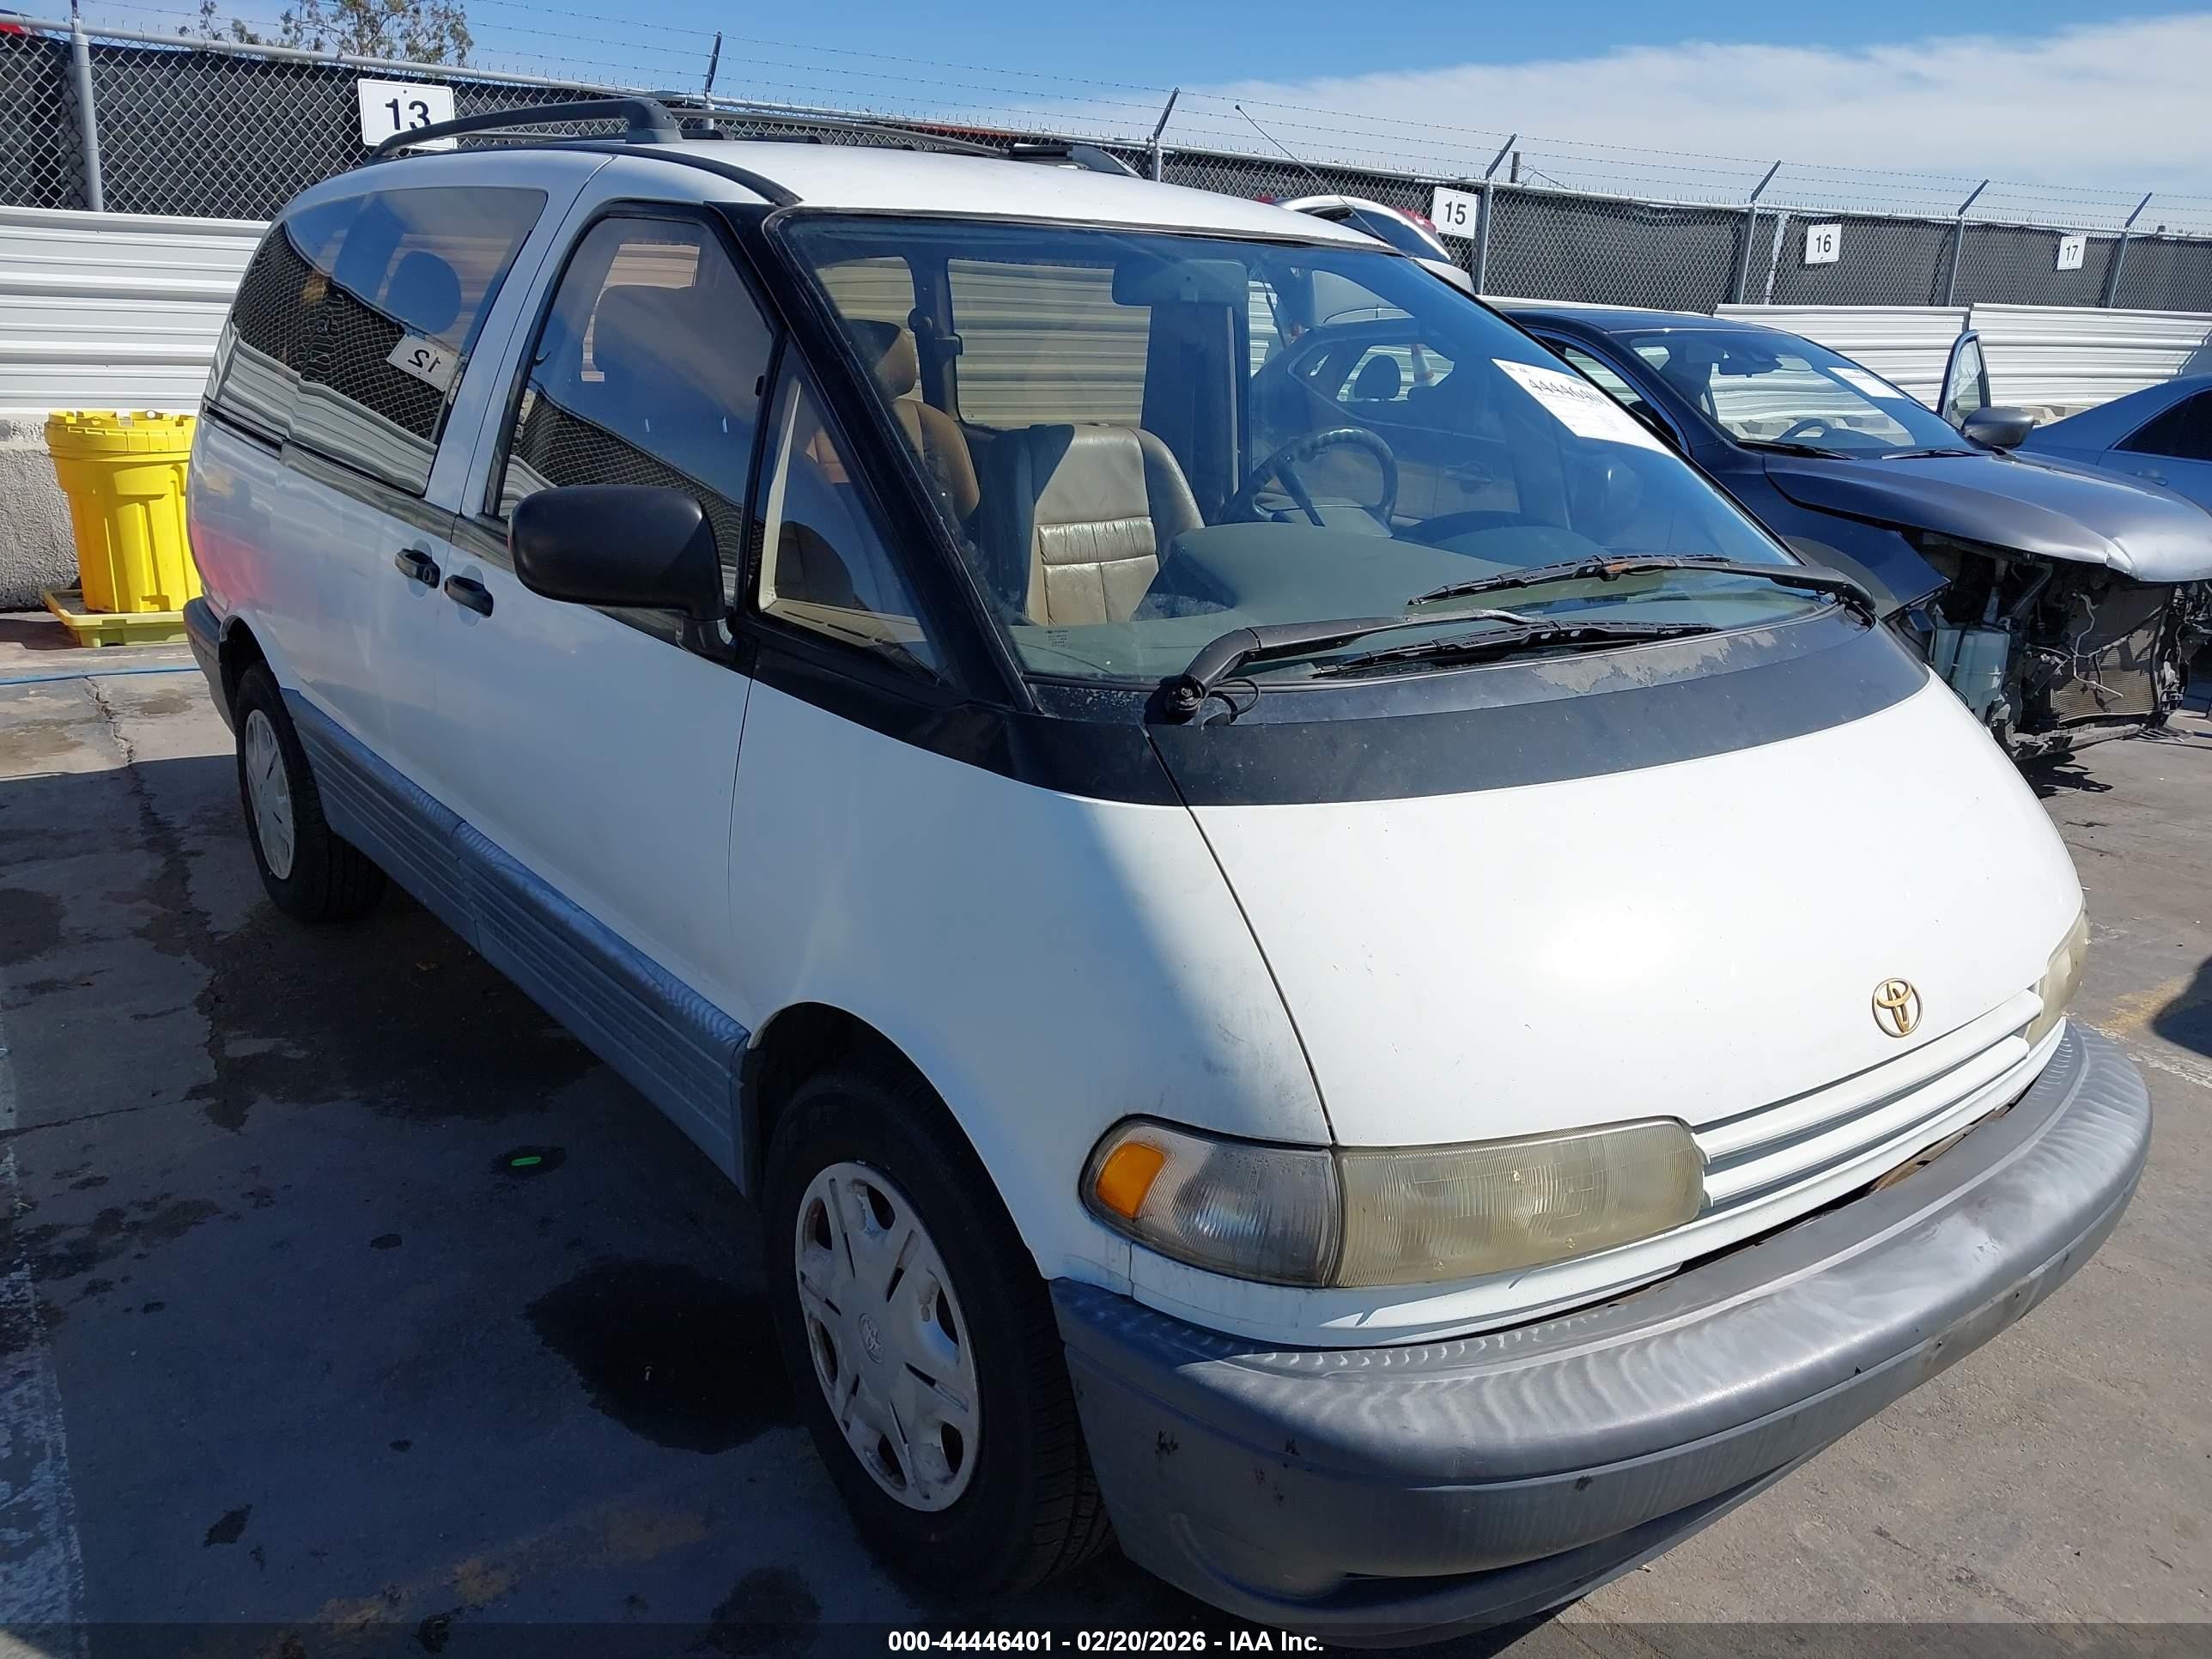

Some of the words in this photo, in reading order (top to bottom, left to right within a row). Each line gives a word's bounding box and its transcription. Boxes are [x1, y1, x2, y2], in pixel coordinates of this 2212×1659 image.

[385, 98, 431, 131] 13
[1445, 201, 1467, 225] 15
[1816, 234, 1832, 252] 16
[2066, 245, 2078, 261] 17
